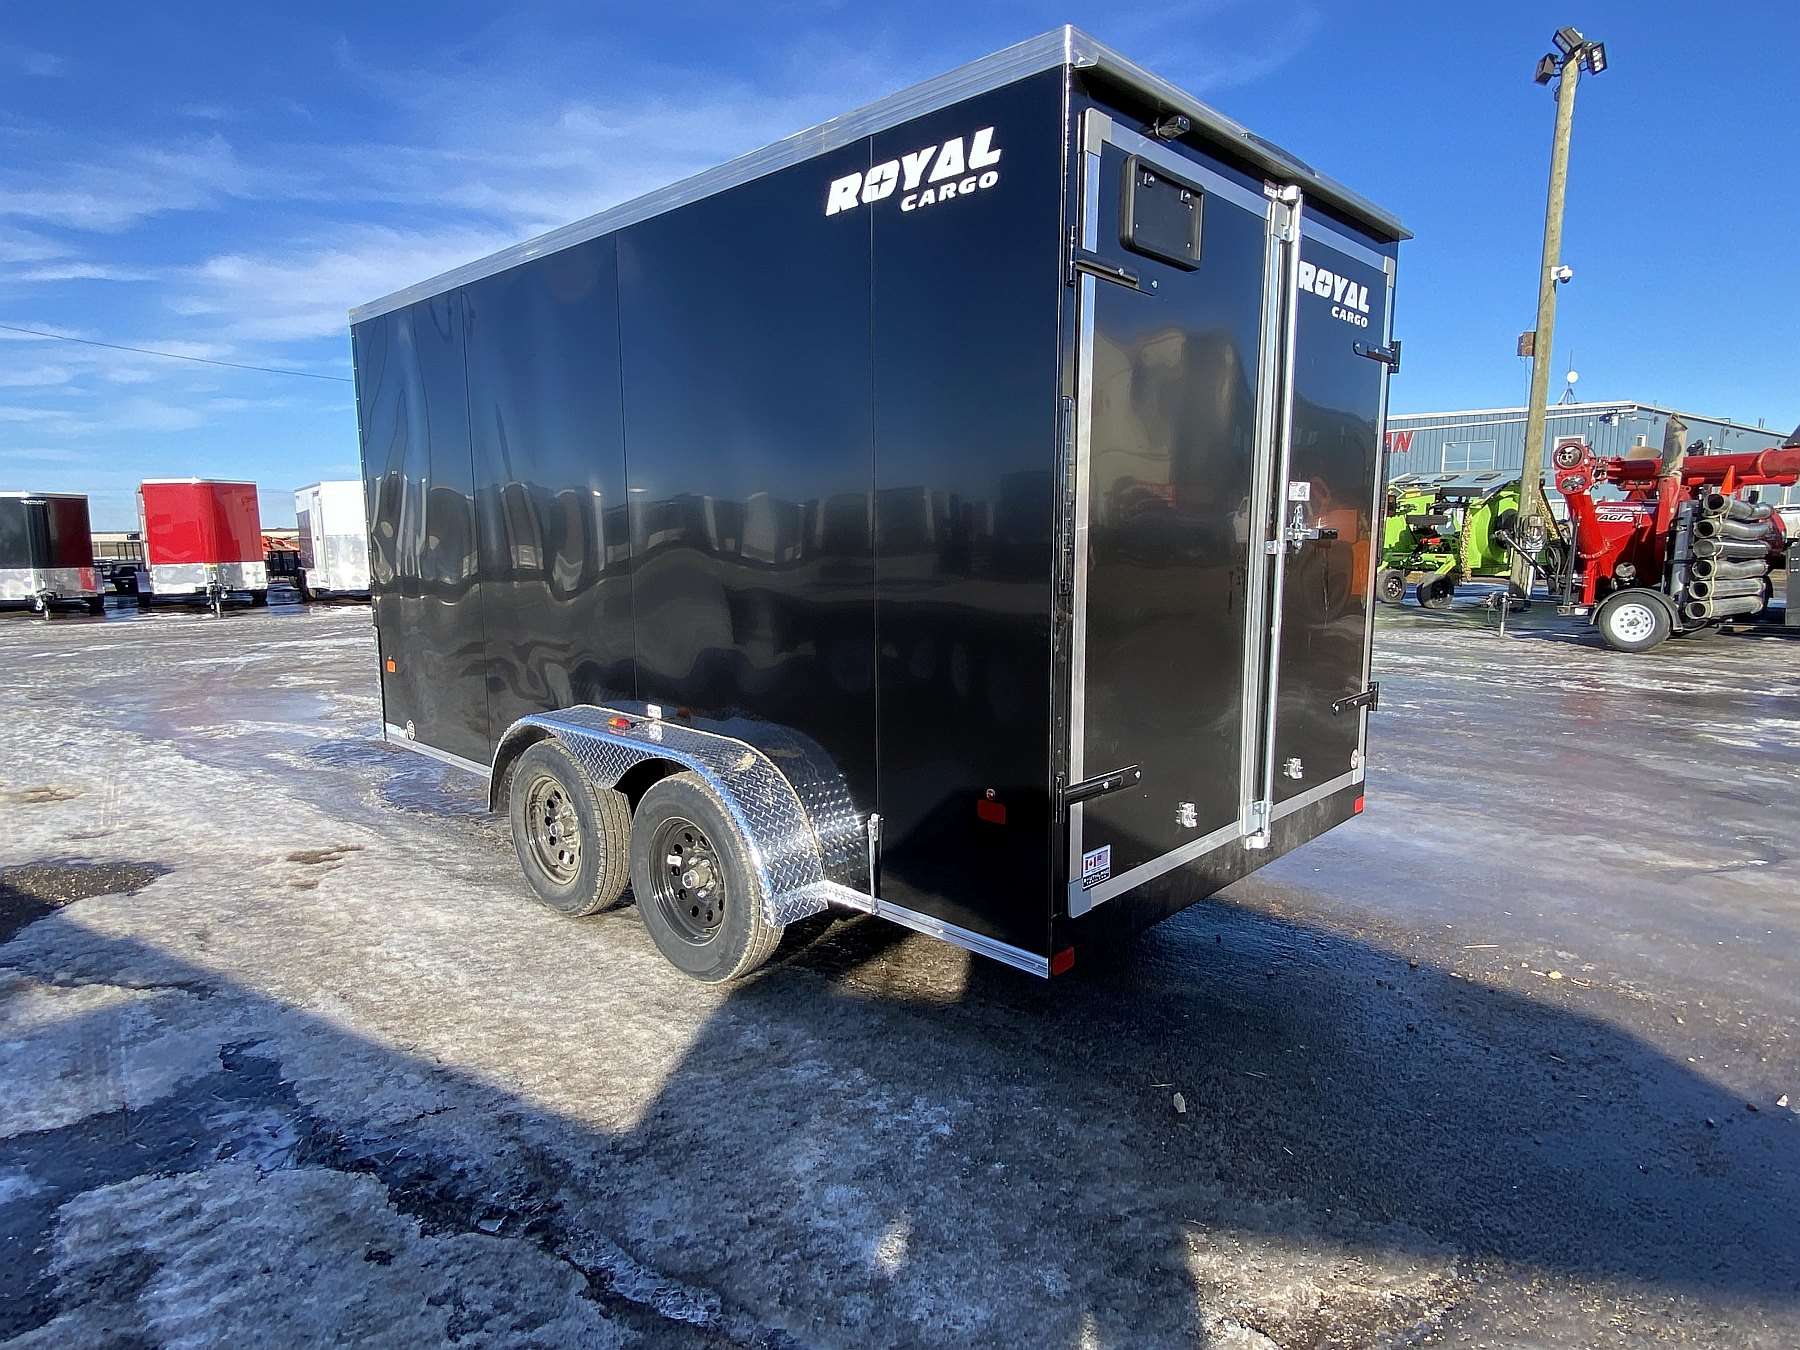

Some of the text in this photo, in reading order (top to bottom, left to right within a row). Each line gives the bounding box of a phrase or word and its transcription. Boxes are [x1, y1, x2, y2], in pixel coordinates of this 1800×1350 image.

[826, 127, 1001, 216] ROYAL
[900, 171, 999, 212] CARGO
[1299, 260, 1370, 314] ROYAL
[1331, 306, 1368, 328] CARGO
